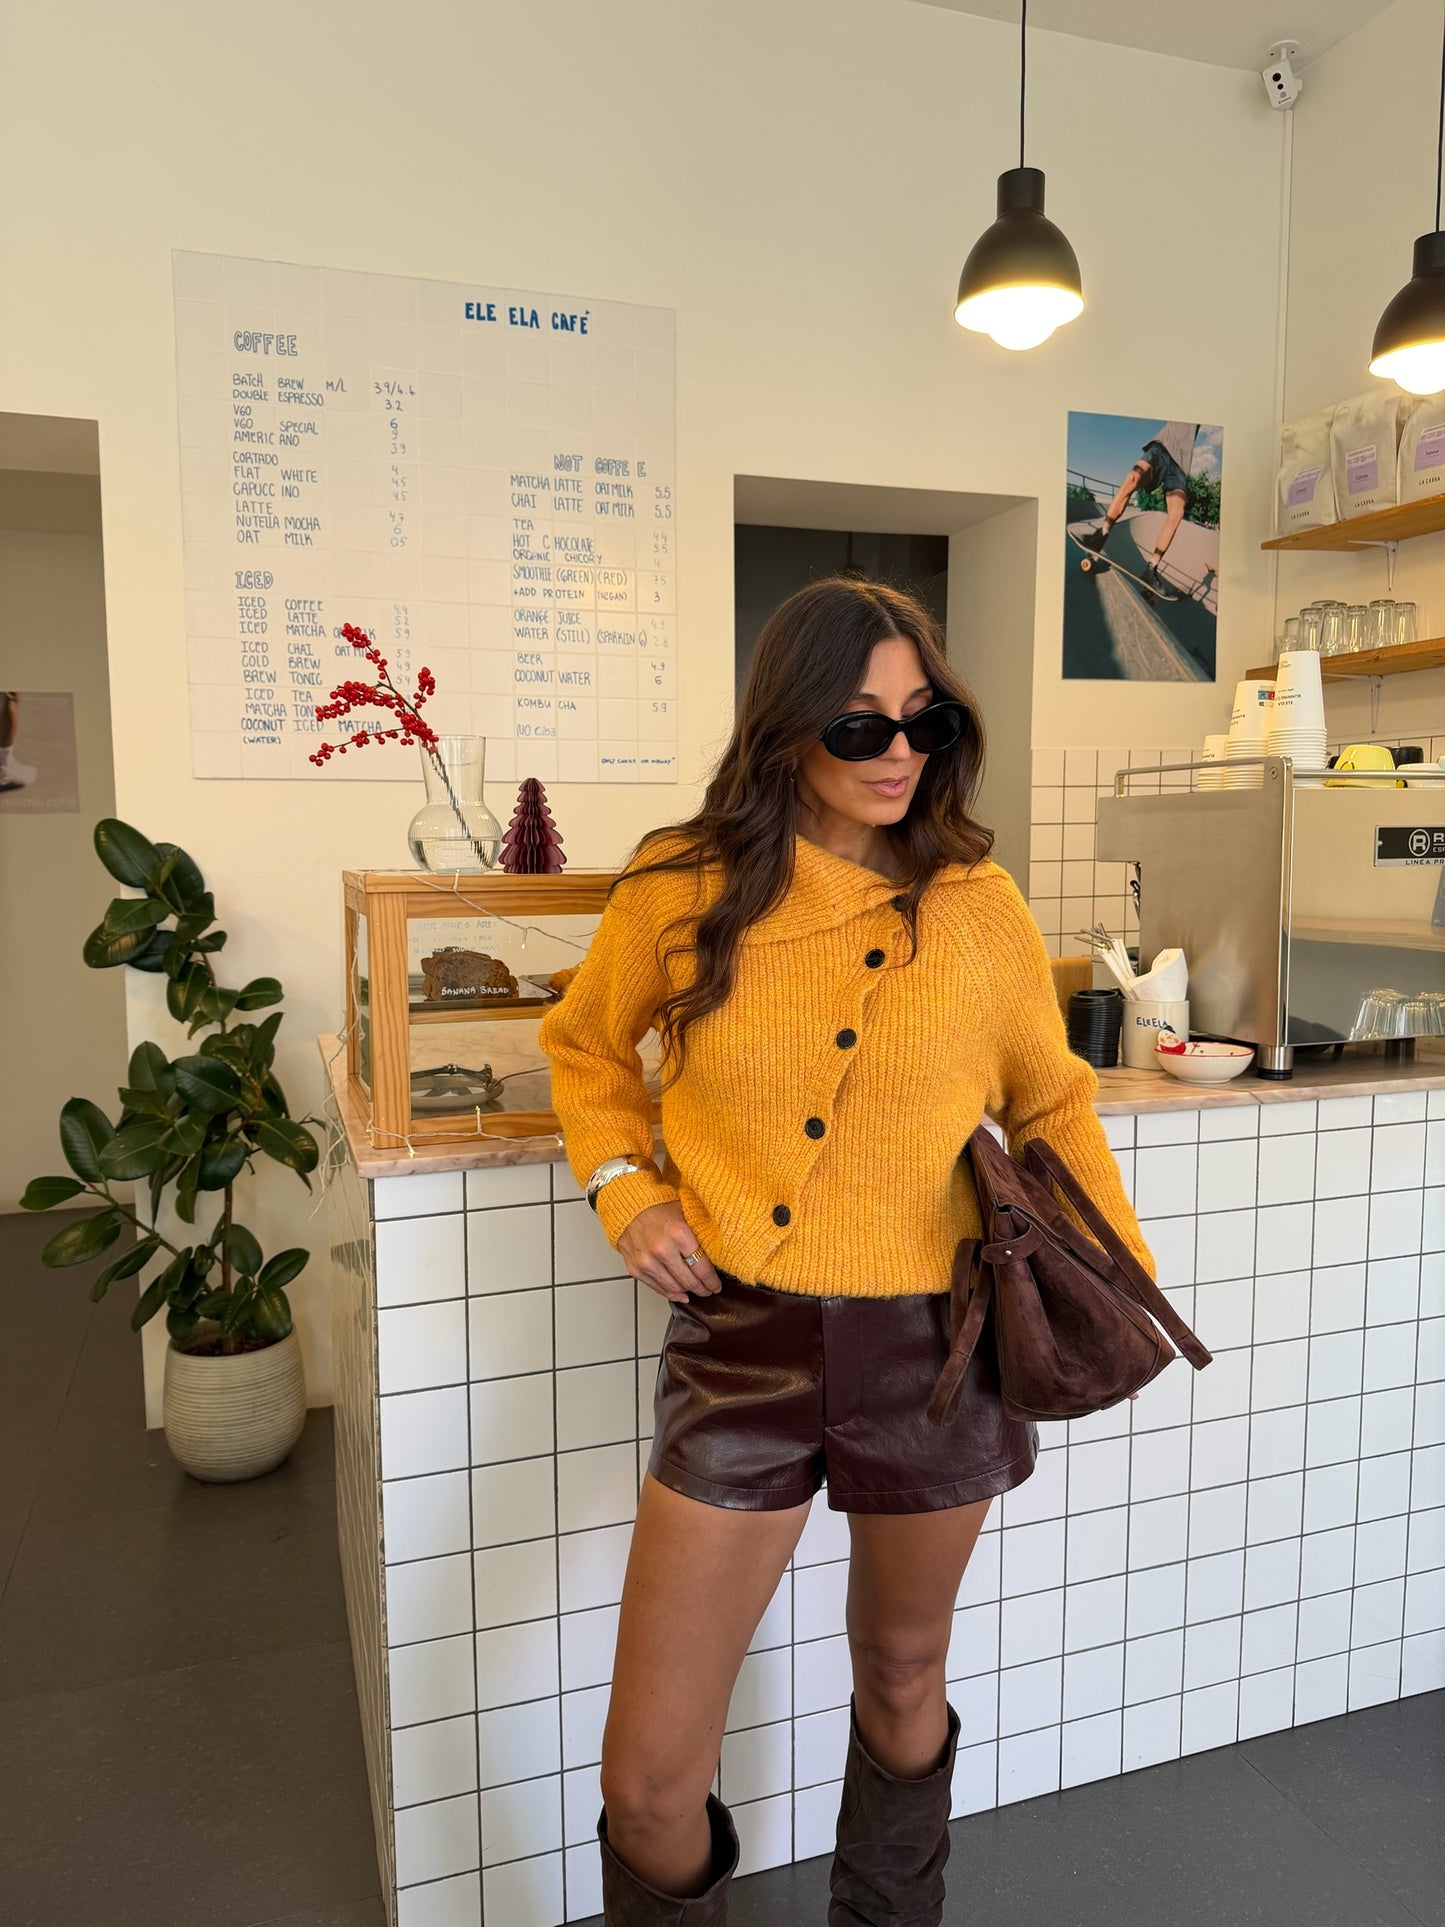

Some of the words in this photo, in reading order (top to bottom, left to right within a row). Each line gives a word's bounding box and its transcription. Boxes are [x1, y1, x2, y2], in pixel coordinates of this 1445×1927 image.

[465, 302, 497, 321] ELE
[509, 307, 540, 329] ELA
[551, 310, 590, 335] CAFÉ
[234, 330, 298, 356] COFFEE
[232, 373, 263, 387] BATCH
[277, 377, 305, 390] BREW
[232, 389, 269, 401] DOUBLE
[277, 391, 324, 407] ESPRESSO
[279, 420, 319, 435] SPECIAL
[391, 429, 398, 440] 9
[389, 417, 398, 429] 6
[232, 451, 279, 466] CORTADO
[391, 464, 398, 476] 4
[554, 454, 583, 472] NOT
[233, 466, 261, 479] FLAT
[280, 469, 318, 483] WHITE
[510, 474, 550, 490] MATCHA
[554, 478, 583, 494] LATTE
[655, 486, 671, 500] 5.5
[235, 500, 273, 515] LATTE
[511, 493, 537, 509] CHAI
[554, 497, 583, 513] LATTE
[654, 504, 672, 519] 5.5
[236, 514, 280, 529] NUTELLA
[284, 516, 321, 531] MOCHA
[393, 523, 402, 535] 6
[513, 518, 534, 531] TEA
[236, 530, 261, 544] OAT
[284, 532, 313, 546] MILK
[512, 533, 531, 548] HOT
[564, 552, 602, 565] CHICORY
[235, 570, 273, 590] ICED
[513, 566, 552, 582] SMOOTHIE
[597, 569, 628, 586] (RED)
[513, 587, 537, 597] +ADD
[653, 592, 661, 603] 3
[238, 596, 266, 608] ICED
[284, 598, 324, 612] COFFEE
[239, 607, 267, 620] ICED
[288, 611, 319, 625] LATTE
[513, 608, 549, 625] ORANGE
[557, 612, 582, 625] JUICE
[239, 621, 268, 634] ICED
[286, 624, 327, 638] MATCHA
[514, 627, 549, 640] WATER
[556, 629, 590, 645] (STILL)
[241, 641, 268, 654] ICED
[287, 643, 314, 656] CHAI
[335, 645, 350, 657] OAT
[241, 655, 269, 667] COLD
[288, 657, 320, 670] BREW
[517, 653, 543, 665] BEER
[243, 670, 277, 683] BREW
[514, 669, 555, 683] COCONUT
[557, 671, 591, 686] WATER
[654, 675, 662, 686] 6
[244, 688, 274, 700] ICED
[292, 690, 312, 702] TEA
[245, 704, 288, 717] MATCHA
[241, 718, 285, 731] COCONUT
[293, 719, 325, 732] ICED
[338, 720, 383, 733] MATCHA
[516, 724, 531, 737] NO
[243, 736, 281, 745] (WATER)
[441, 986, 476, 996] BANANA
[480, 985, 509, 995] BREAD
